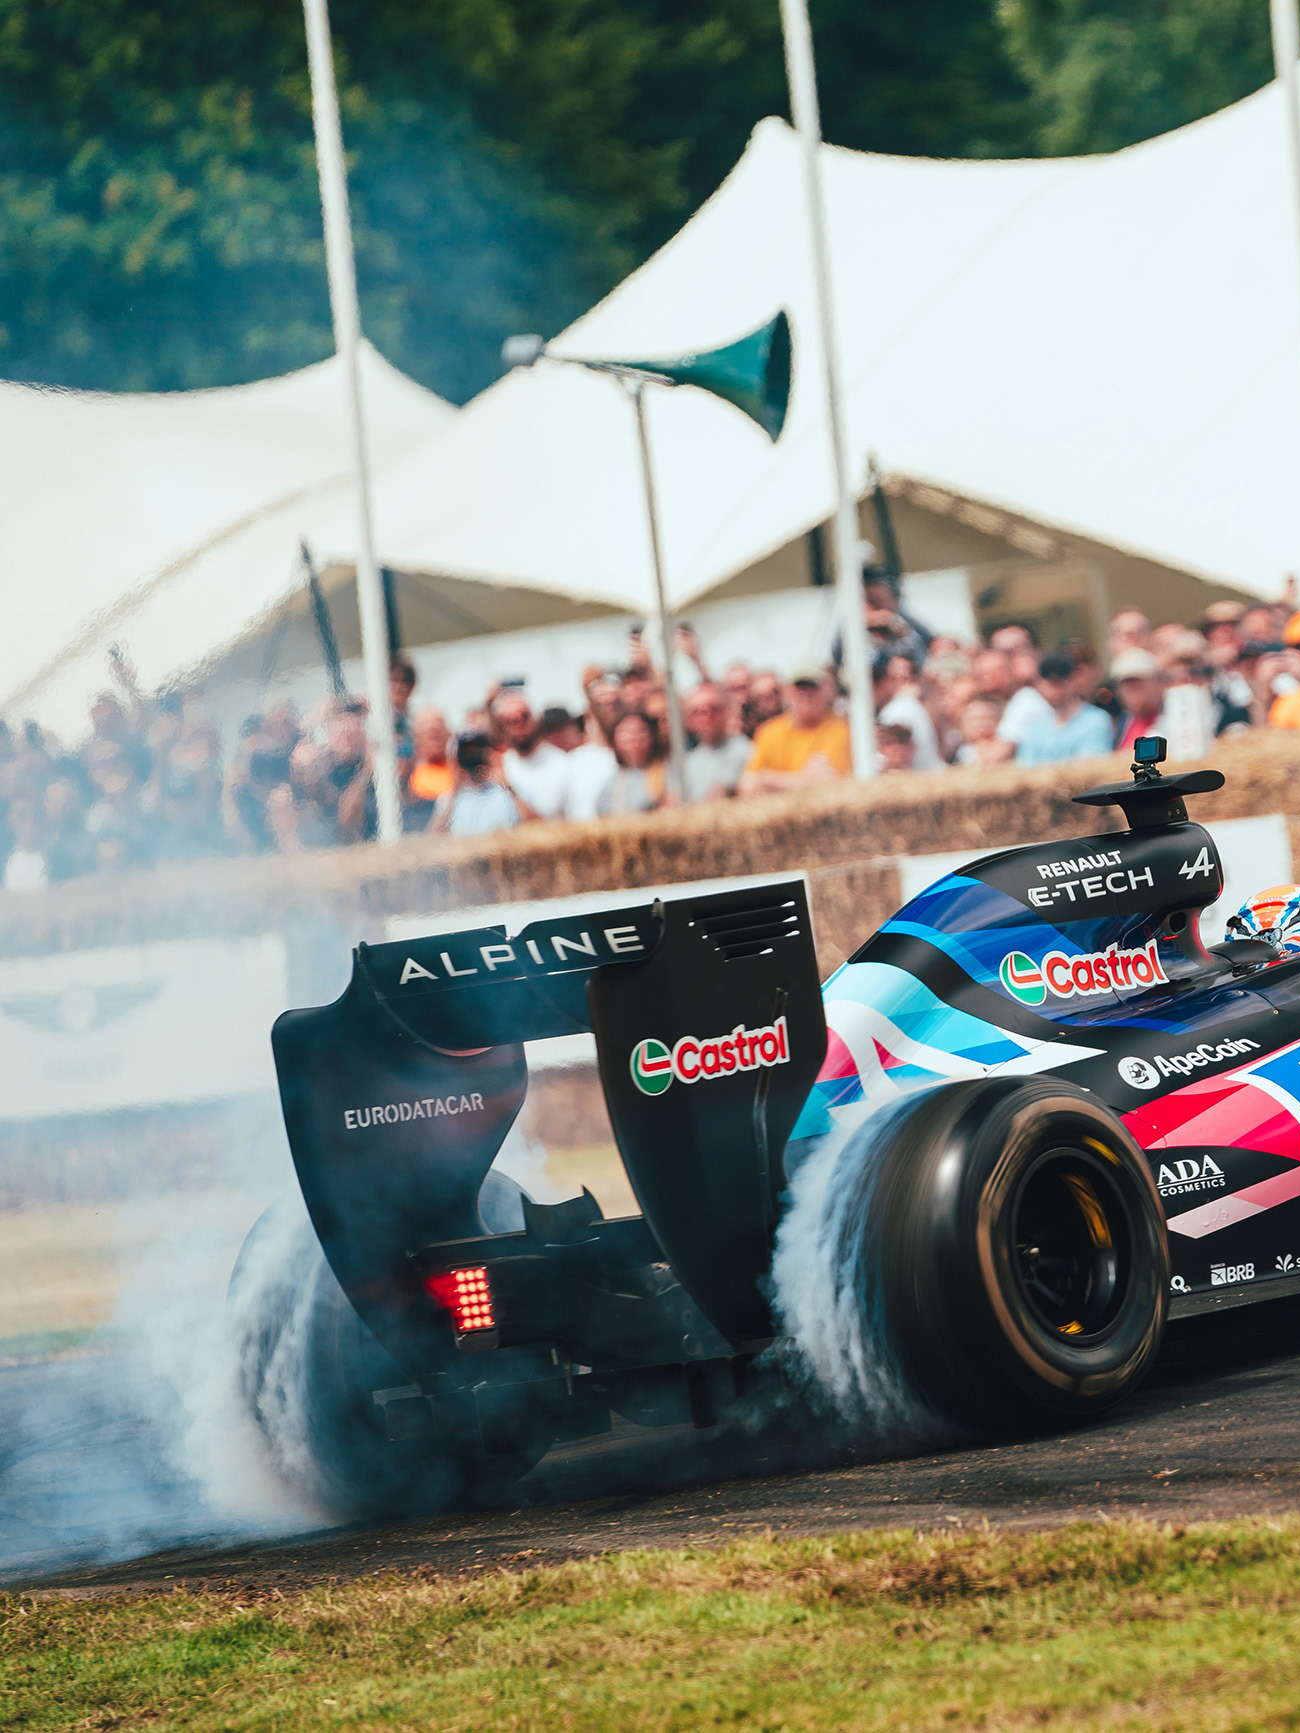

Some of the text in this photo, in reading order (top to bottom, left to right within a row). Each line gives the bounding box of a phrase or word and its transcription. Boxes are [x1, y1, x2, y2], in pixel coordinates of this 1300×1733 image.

[1035, 849, 1123, 880] RENAULT
[1027, 866, 1155, 908] E-TECH
[400, 925, 644, 985] ALPINE
[1042, 941, 1169, 998] Castrol
[671, 1017, 790, 1084] Castrol
[1153, 1036, 1261, 1082] ApeCoin
[343, 1092, 485, 1130] EURODATACAR
[1156, 1154, 1225, 1186] ADA
[1159, 1178, 1226, 1197] COSMETICS
[1226, 1262, 1256, 1284] BRB
